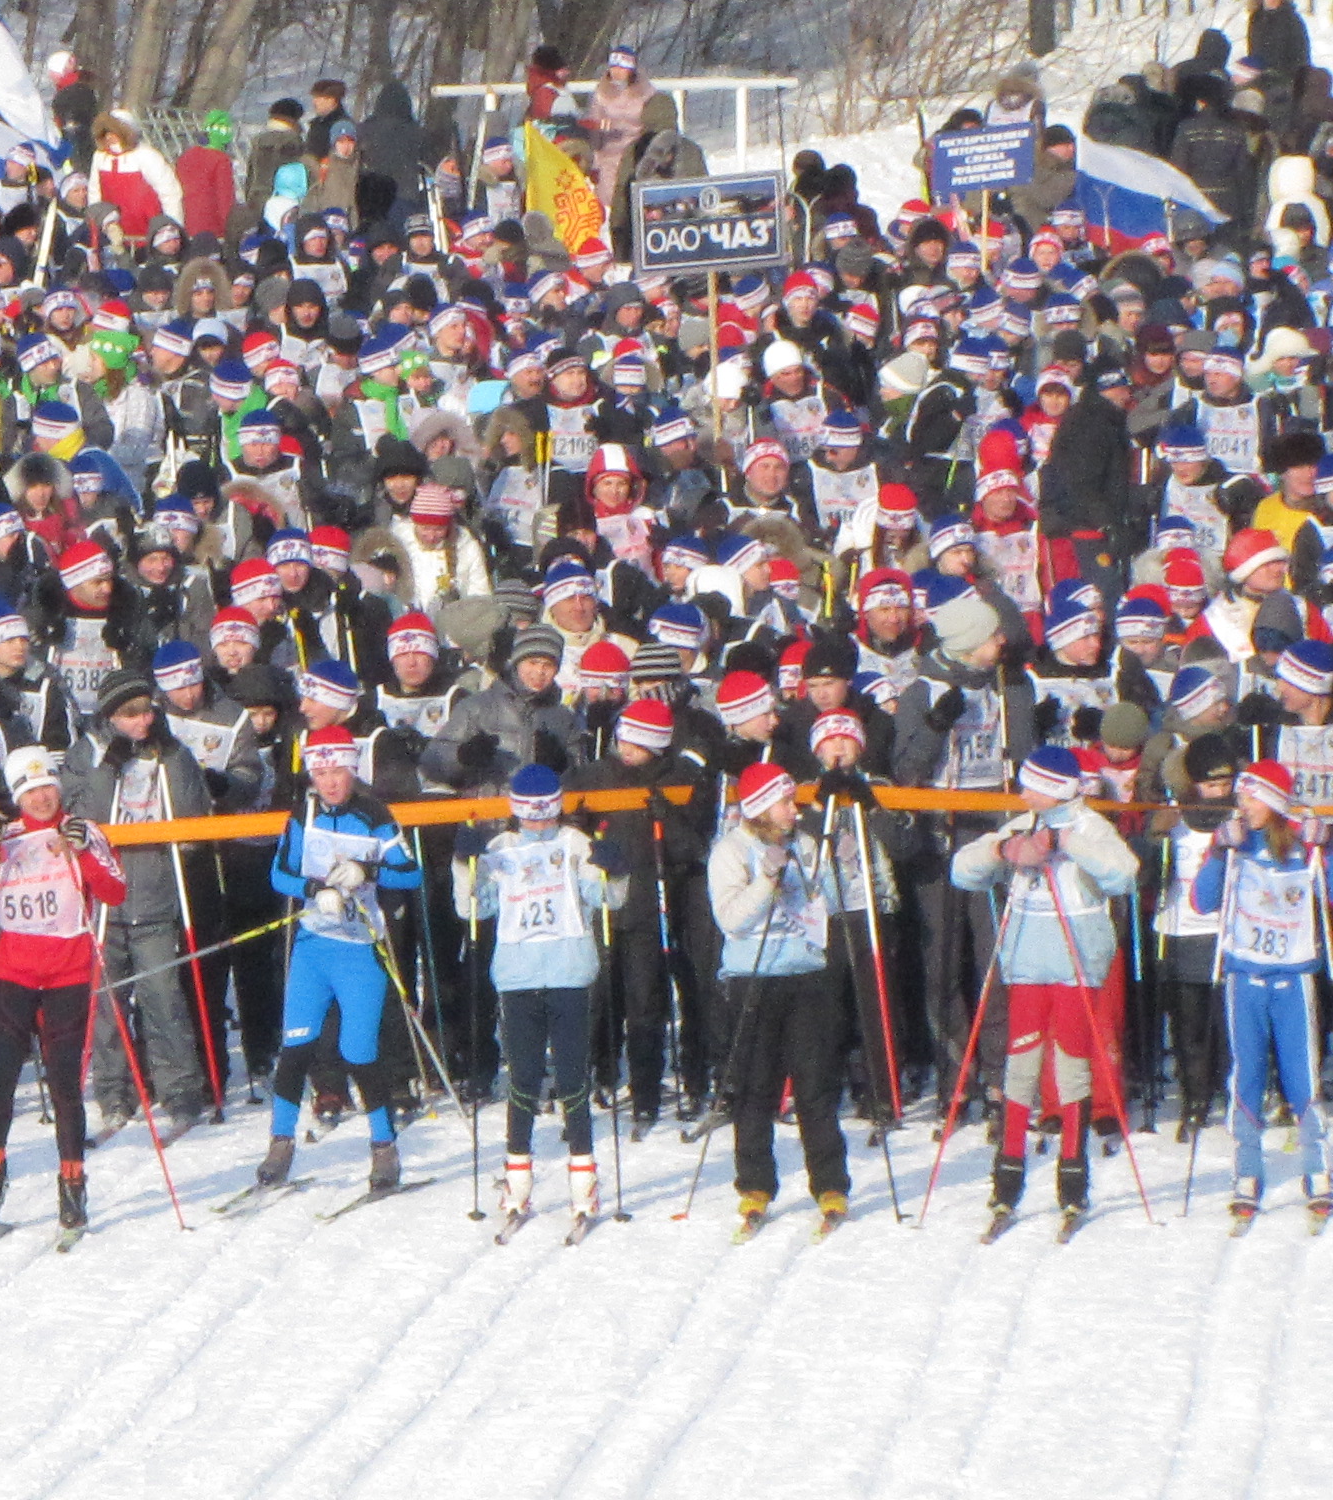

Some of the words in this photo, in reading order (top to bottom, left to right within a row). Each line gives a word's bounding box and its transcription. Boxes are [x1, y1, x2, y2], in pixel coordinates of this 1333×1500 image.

[964, 152, 1006, 164] СЛУЖБА
[646, 227, 701, 254] ОАО
[2, 890, 60, 921] 5618
[1248, 926, 1290, 957] 283
